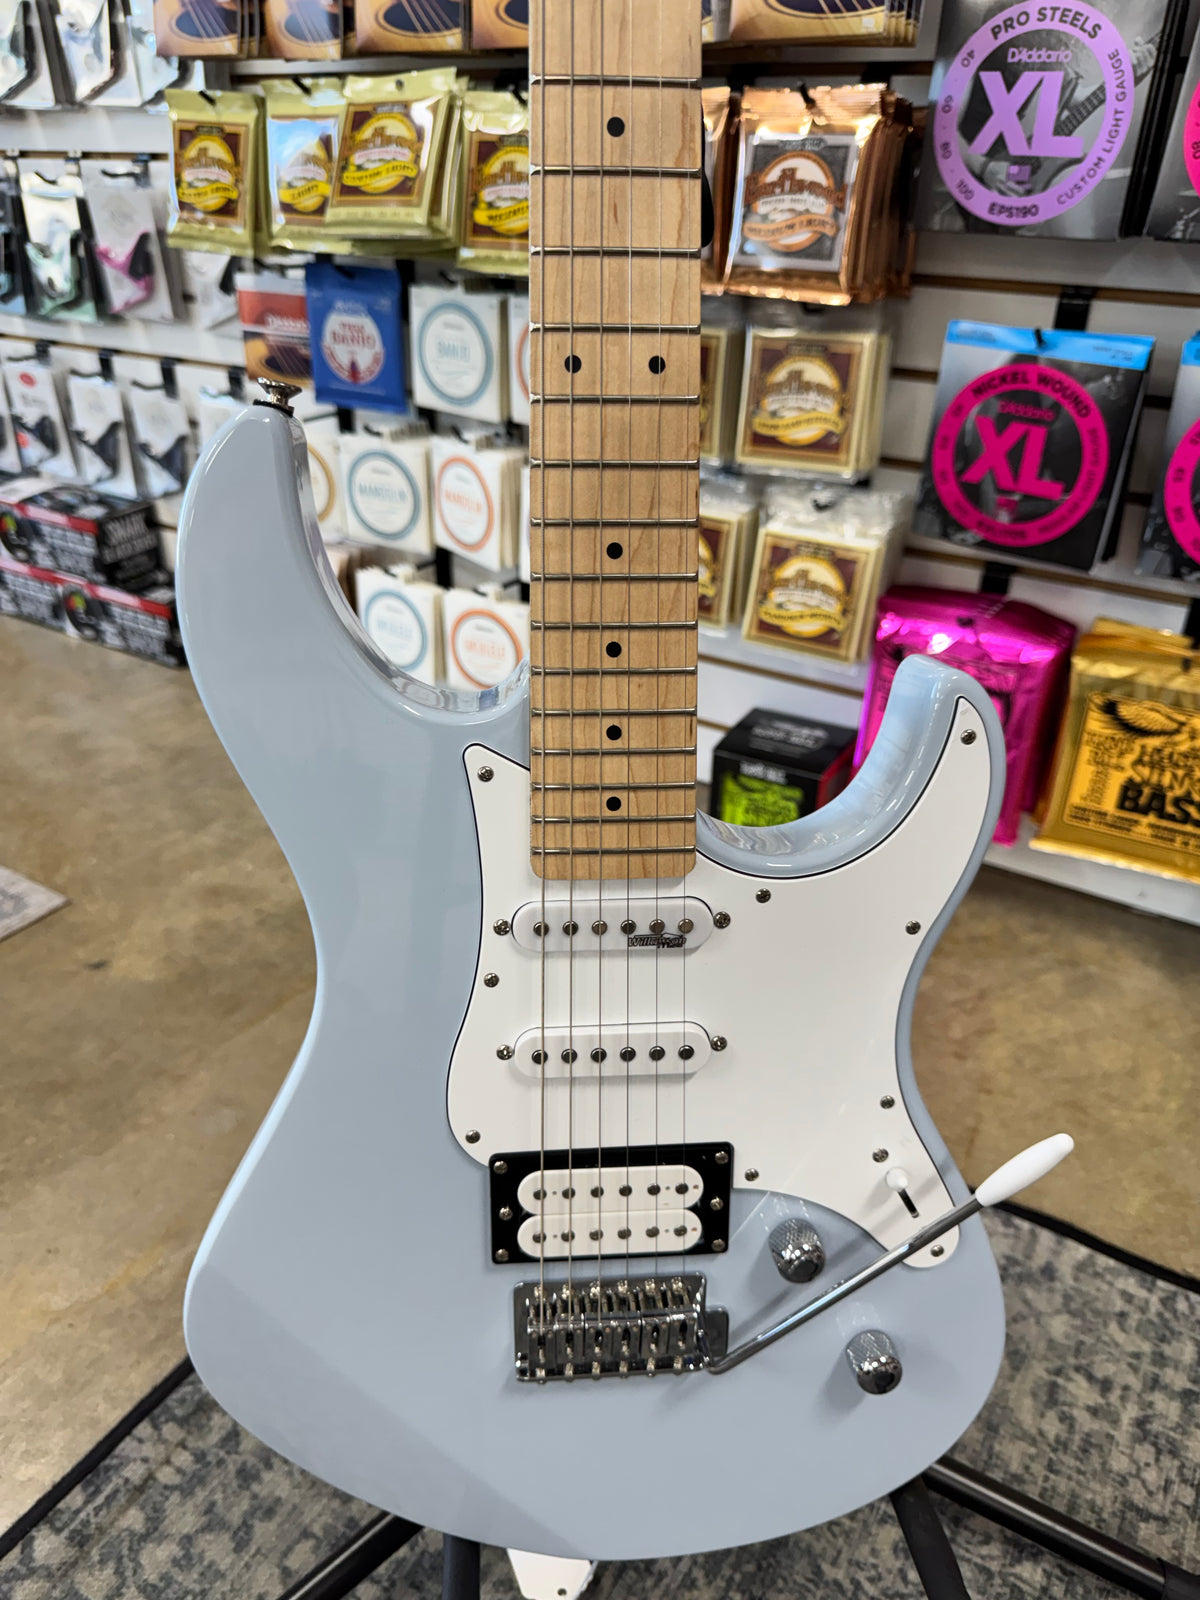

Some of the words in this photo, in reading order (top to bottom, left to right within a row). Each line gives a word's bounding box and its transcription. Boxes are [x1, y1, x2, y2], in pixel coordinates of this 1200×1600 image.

[990, 10, 1031, 41] PRO
[1036, 6, 1102, 40] STEELS
[1007, 47, 1072, 63] D'Addario
[1107, 48, 1128, 103] GAUGE
[968, 70, 1085, 158] XL
[1103, 108, 1126, 155] LIGHT
[1056, 156, 1106, 206] CUSTOM
[988, 201, 1040, 219] EPS190
[971, 372, 1030, 398] NICKEL
[1037, 373, 1091, 419] WOUND
[960, 414, 1066, 502] XL
